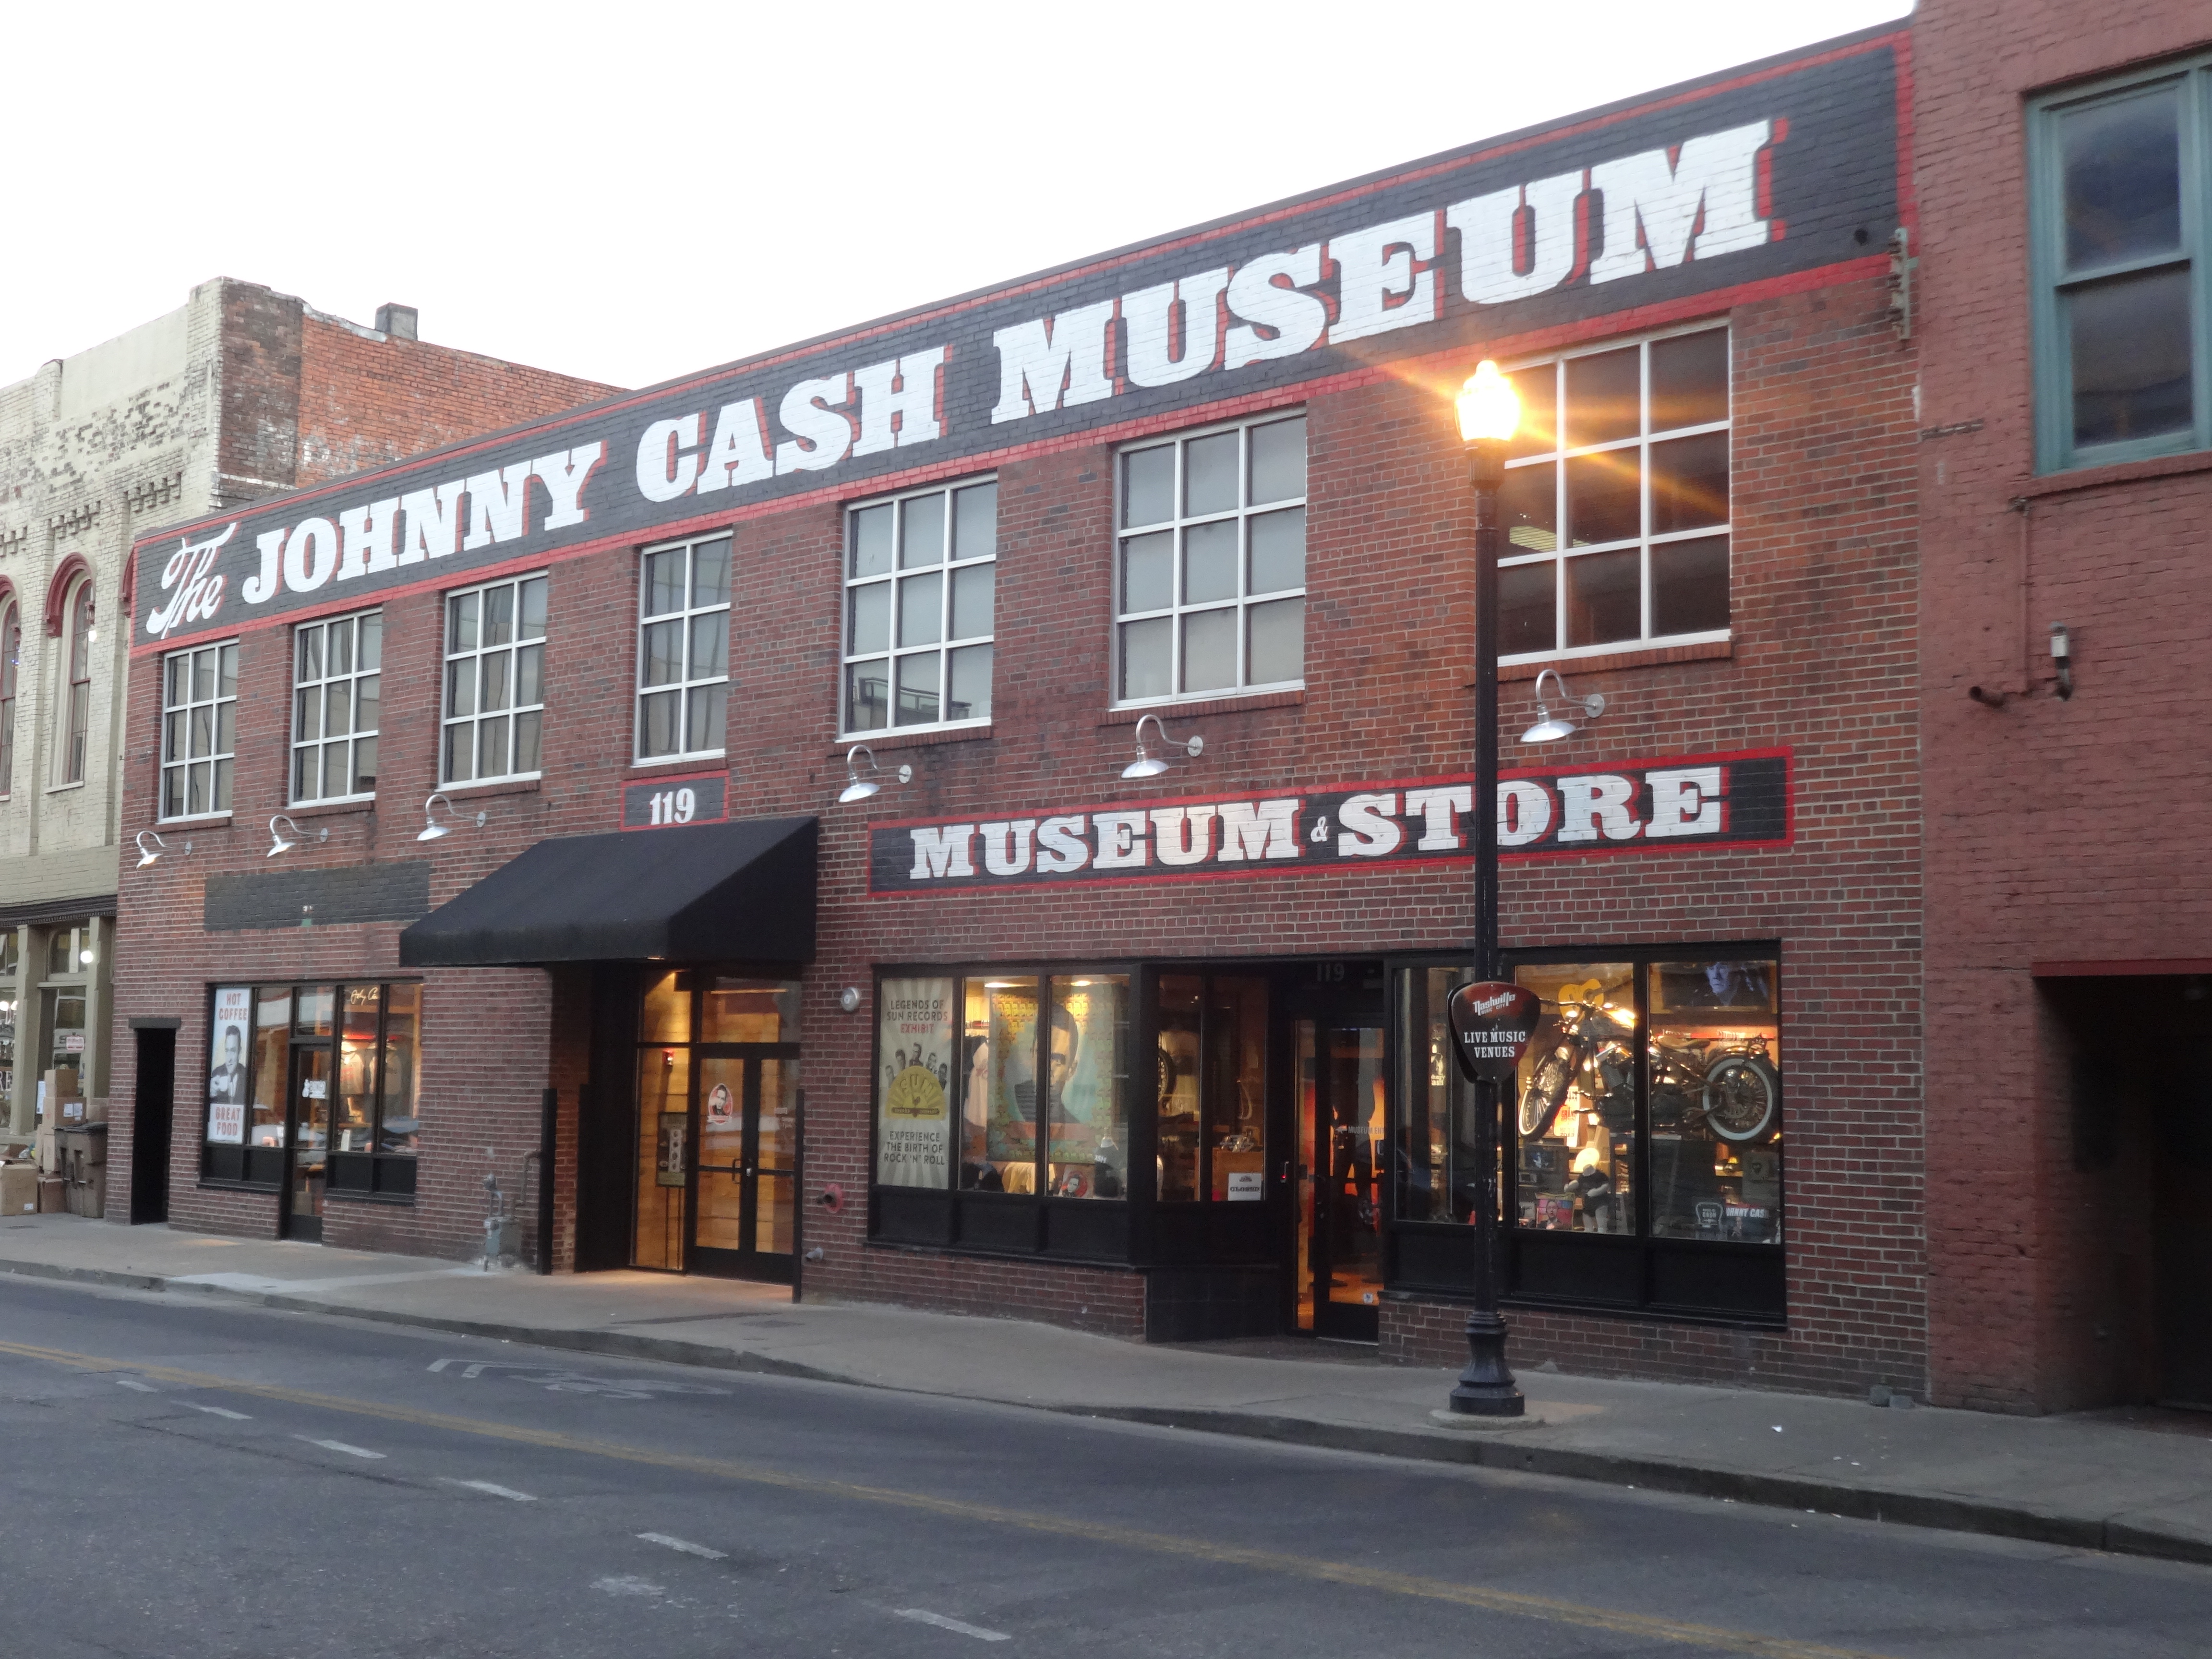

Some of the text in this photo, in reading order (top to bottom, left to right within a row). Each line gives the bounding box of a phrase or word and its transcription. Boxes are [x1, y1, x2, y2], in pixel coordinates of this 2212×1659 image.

[145, 118, 1776, 640] The JOHNNY CASH MUSEUM
[649, 788, 695, 825] 119
[909, 766, 1722, 880] MUSEUM & STORE
[1317, 963, 1345, 982] 119
[227, 993, 241, 1006] HOT
[890, 999, 944, 1010] LEGENDS OF
[1472, 992, 1516, 1016] Nashville
[219, 1008, 247, 1021] COFFEE
[887, 1011, 948, 1022] SUN RECORDS
[901, 1023, 934, 1034] EXHIBIT
[1464, 1031, 1526, 1044] LIVE MUSIC
[1474, 1046, 1515, 1058] VENUES
[216, 1106, 241, 1121] GREAT
[216, 1121, 238, 1136] FOOD
[1348, 1126, 1373, 1134] MUSEUM
[890, 1130, 940, 1142] EXPERIENCE
[887, 1142, 943, 1154] THE BIRTH OF
[884, 1153, 907, 1163] ROCK
[924, 1155, 945, 1166] ROLL
[1725, 1207, 1749, 1217] OHNNY
